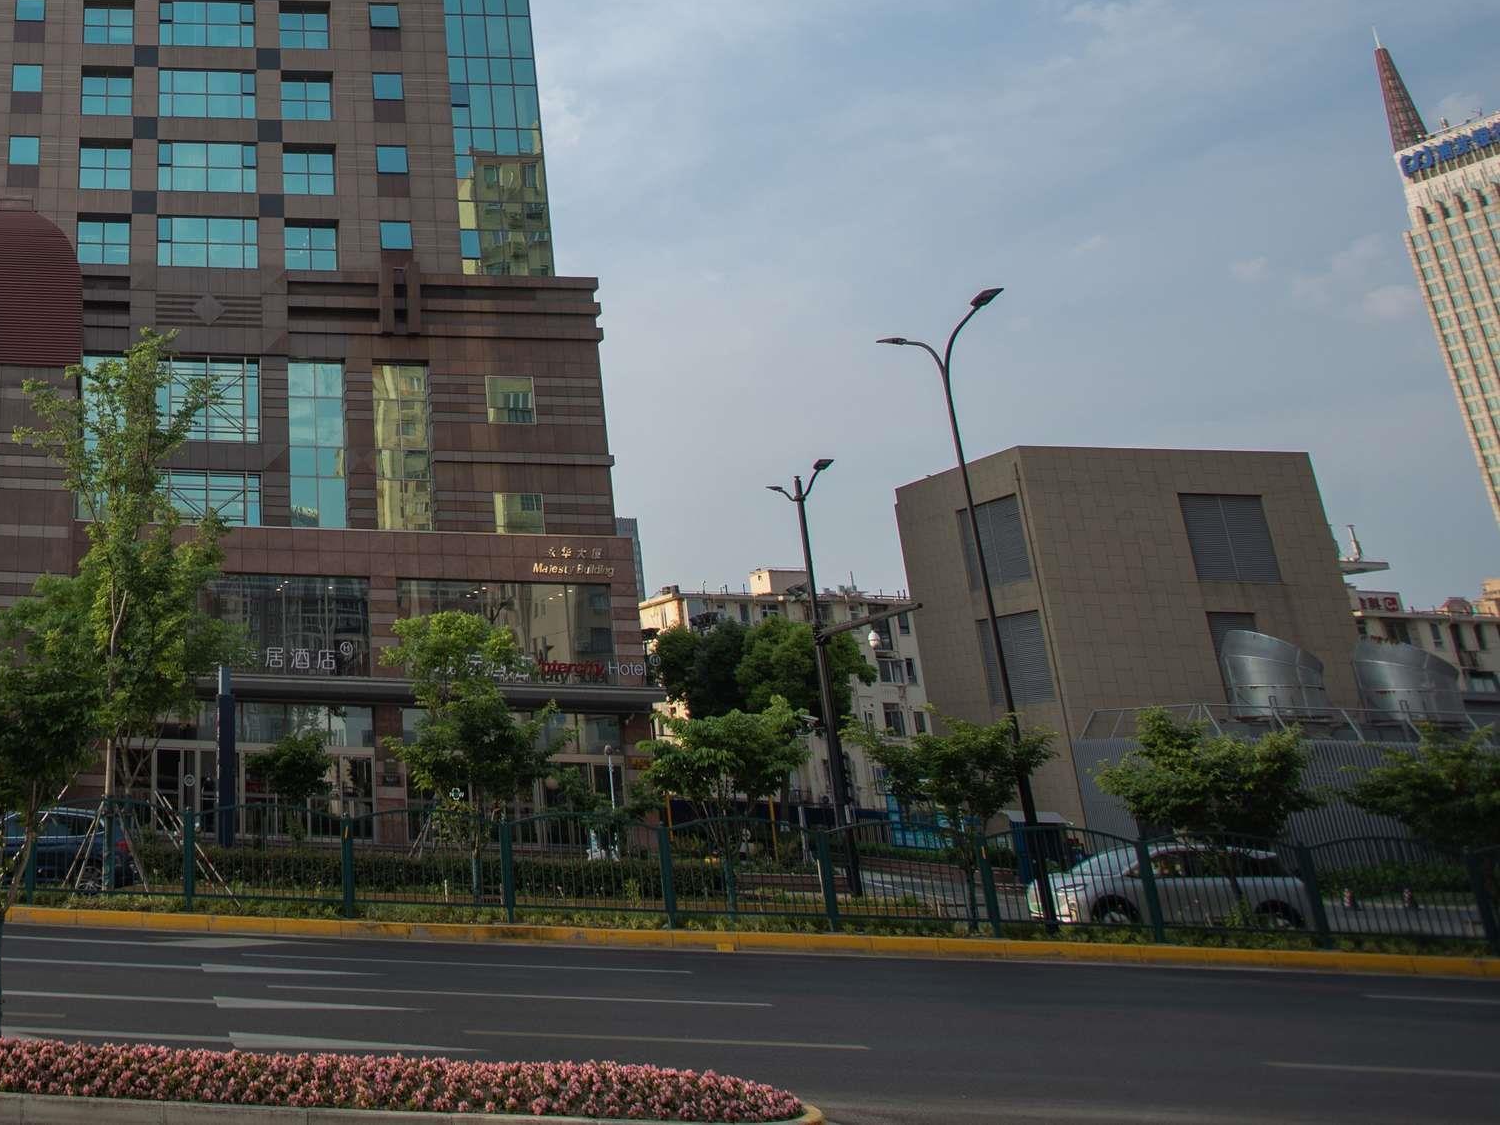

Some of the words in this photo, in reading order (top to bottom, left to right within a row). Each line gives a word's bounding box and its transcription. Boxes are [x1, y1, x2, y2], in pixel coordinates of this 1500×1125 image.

[532, 562, 575, 576] Majesty
[576, 563, 615, 578] Building
[608, 658, 647, 676] Hotel
